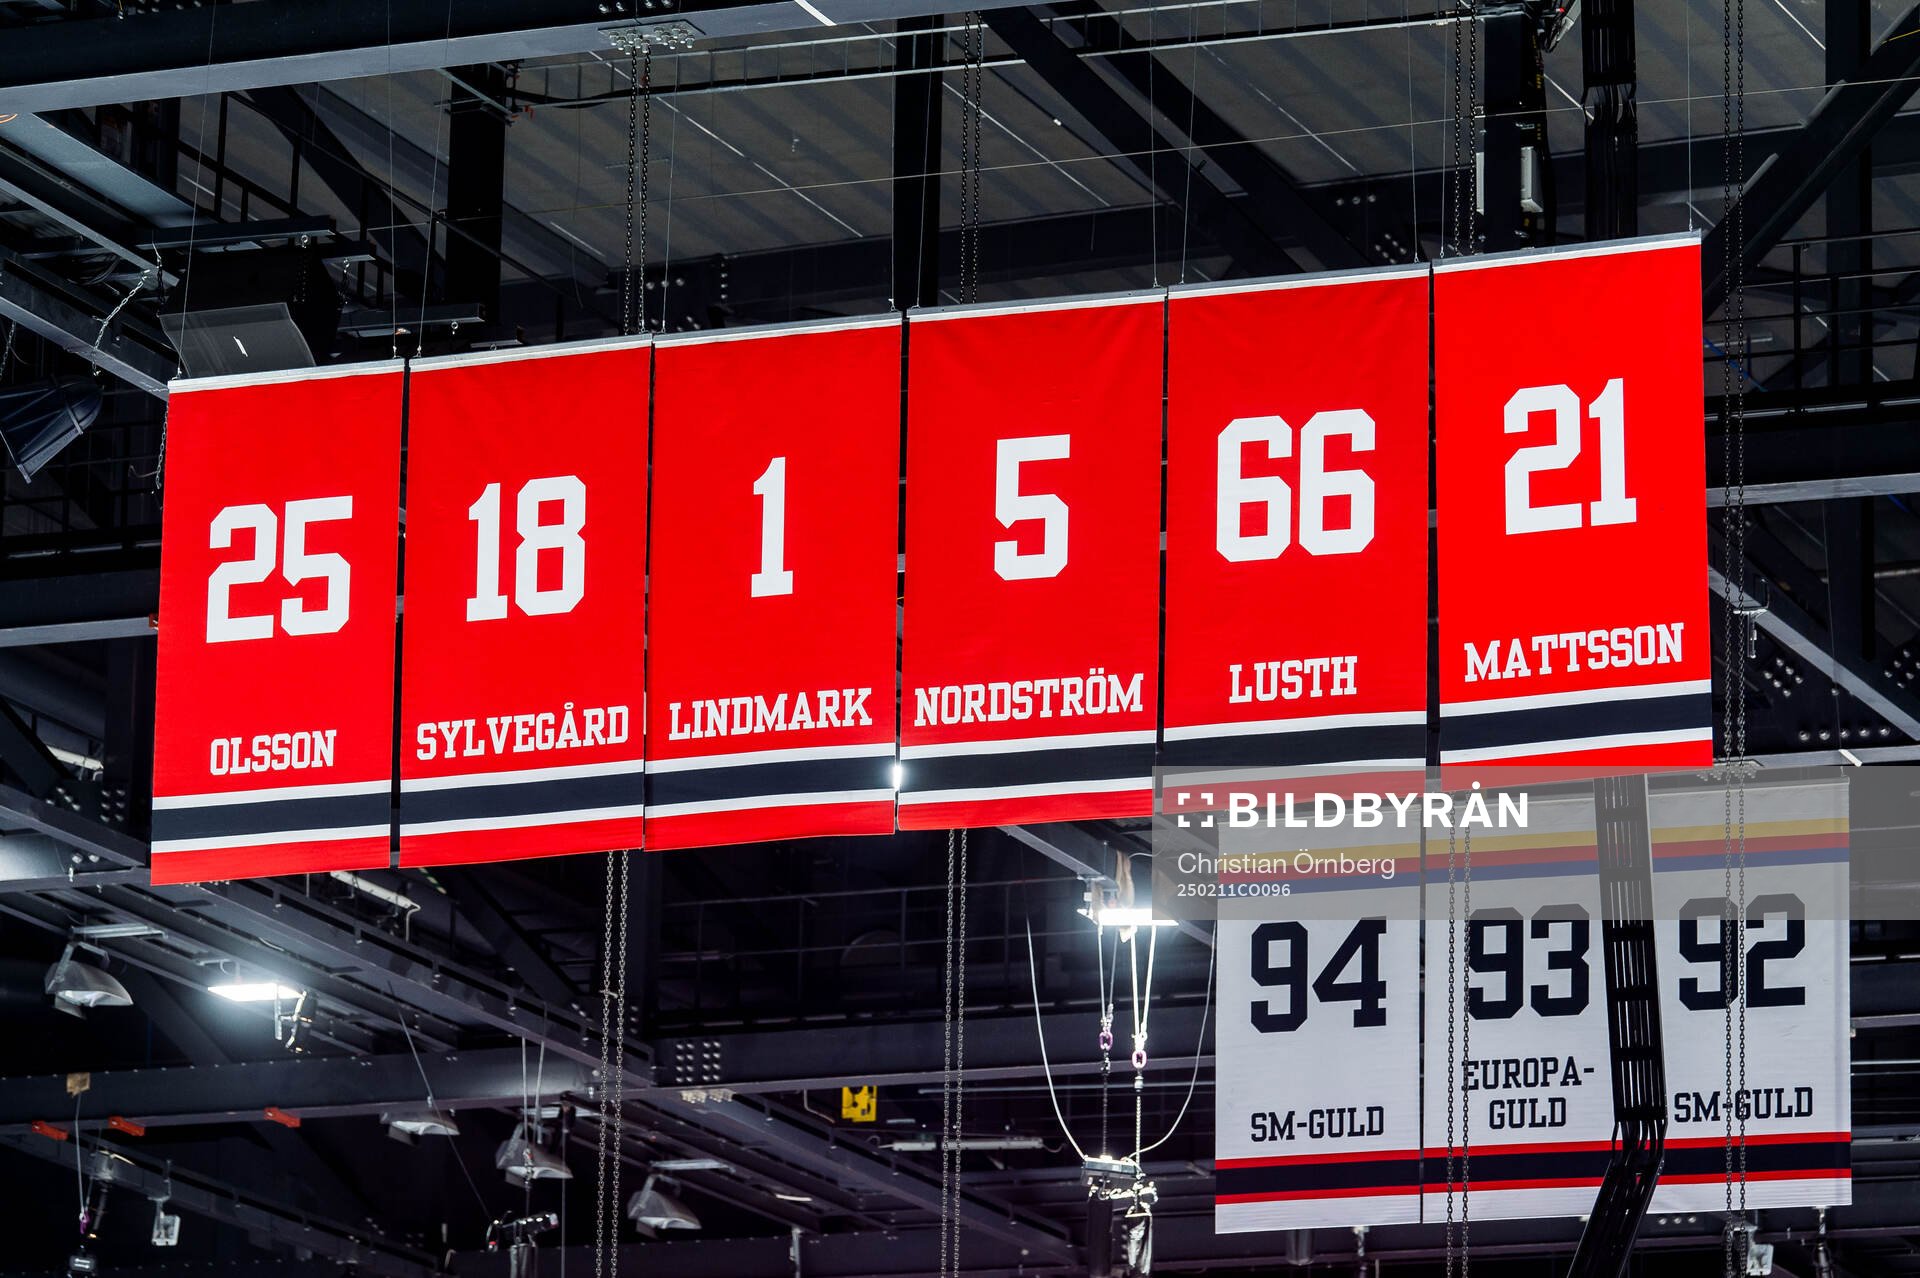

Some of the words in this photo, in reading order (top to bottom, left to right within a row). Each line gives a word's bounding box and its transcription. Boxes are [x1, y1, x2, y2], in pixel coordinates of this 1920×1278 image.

[1216, 408, 1377, 563] 66
[1503, 377, 1638, 536] 21
[751, 456, 795, 598] 1
[994, 433, 1071, 581] 5
[206, 495, 353, 644] 25
[466, 475, 586, 622] 18
[1229, 655, 1359, 705] LUSTH
[1463, 622, 1686, 684] MATTSSON
[668, 687, 873, 742] LINDMARK
[913, 668, 1144, 727] NORDSTRÖM
[209, 729, 337, 777] OLSSON
[416, 701, 629, 762] SYLVEGÅRD
[1250, 915, 1387, 1034] 94
[1467, 903, 1590, 1021] 93
[1678, 892, 1806, 1012] 92
[1461, 1055, 1595, 1092] EUROPA-
[1250, 1105, 1385, 1143] SM-GULD
[1488, 1096, 1567, 1130] GULD
[1673, 1086, 1813, 1124] SM-GULD
